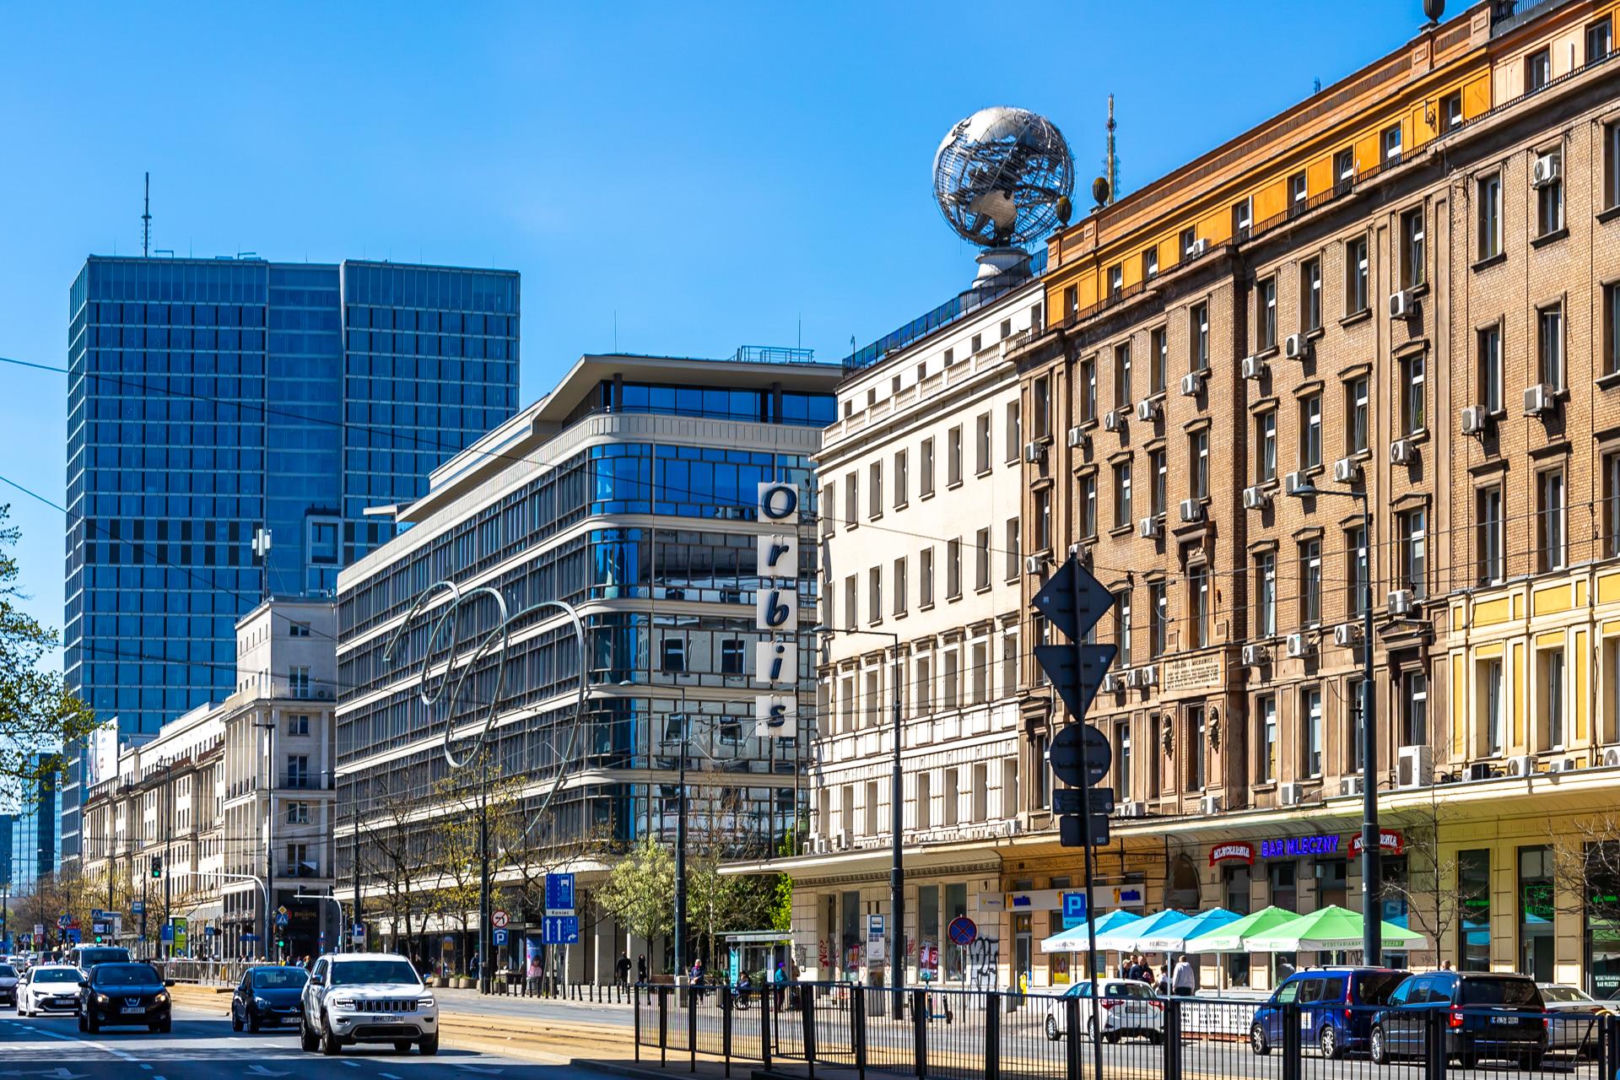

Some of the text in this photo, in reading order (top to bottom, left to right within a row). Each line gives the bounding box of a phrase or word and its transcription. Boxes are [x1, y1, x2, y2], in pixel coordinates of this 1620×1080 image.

[761, 486, 797, 728] Orbis
[1261, 834, 1340, 858] BAR MLECZNY
[1068, 896, 1082, 914] P
[496, 933, 505, 944] P
